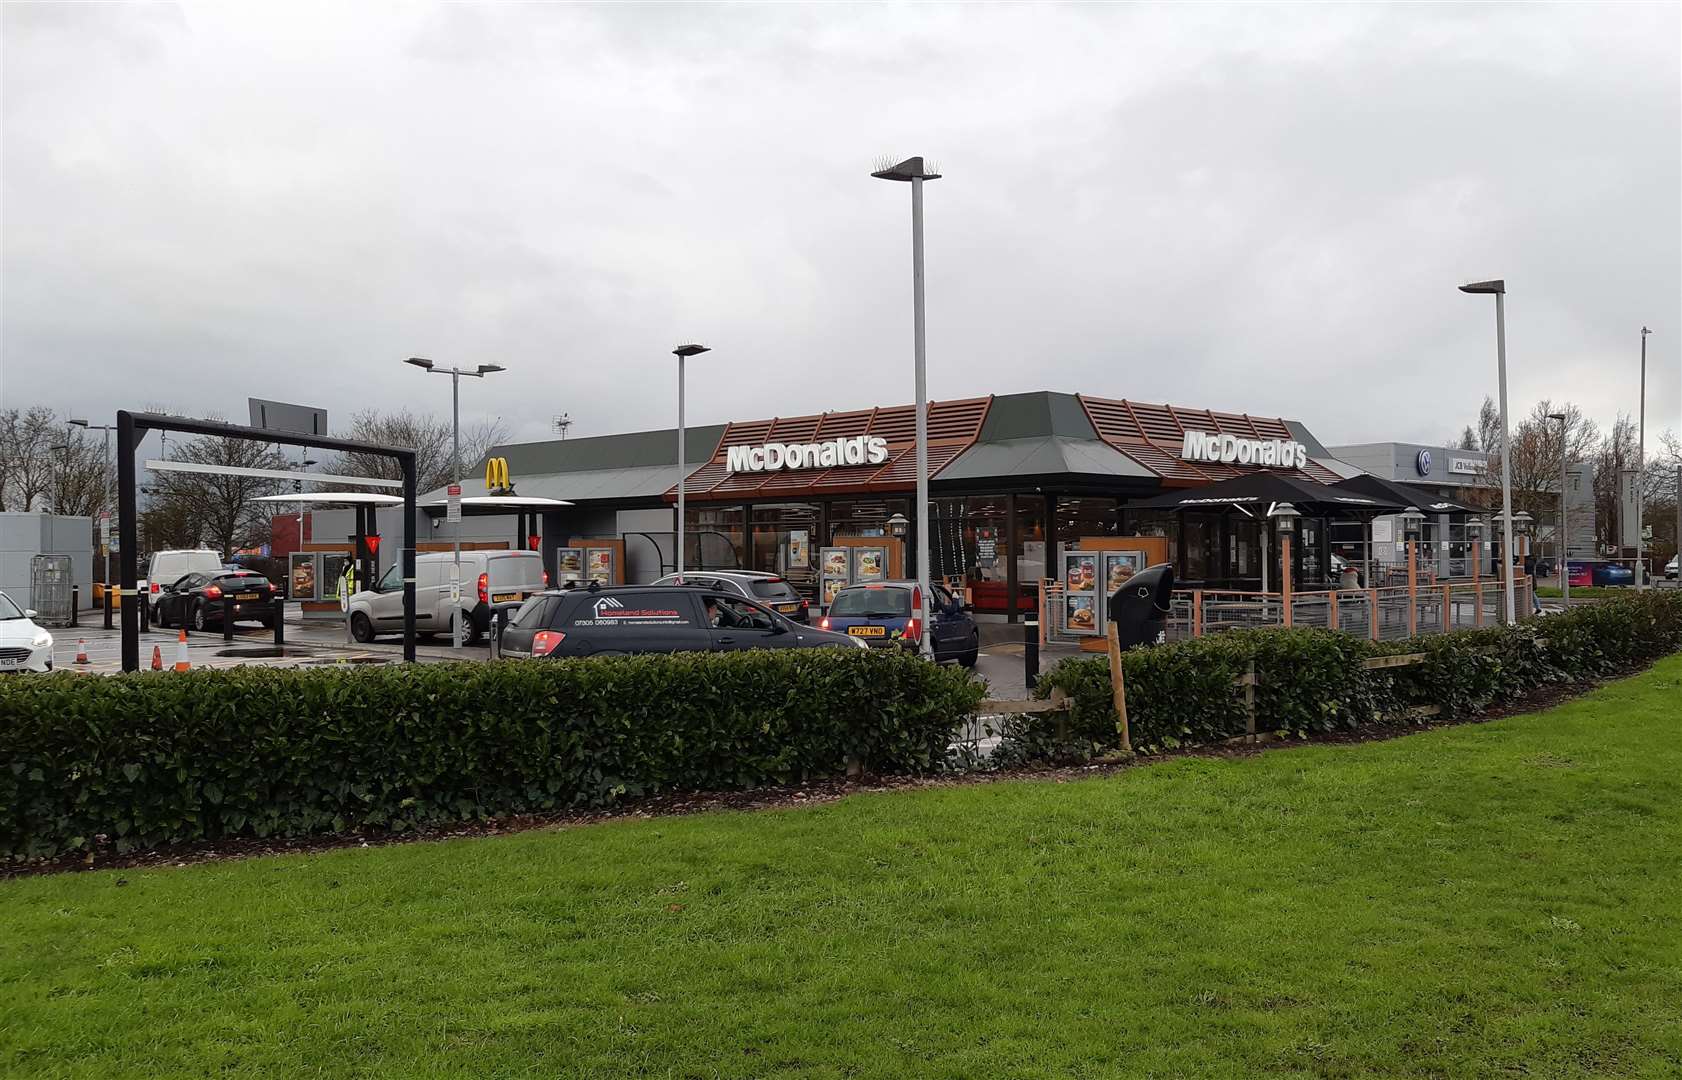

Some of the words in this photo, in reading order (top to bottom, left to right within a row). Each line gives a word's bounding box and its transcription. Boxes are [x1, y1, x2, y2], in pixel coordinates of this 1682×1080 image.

[726, 435, 889, 472] McDonald's
[1181, 430, 1306, 468] McDonald's
[851, 627, 868, 635] W727
